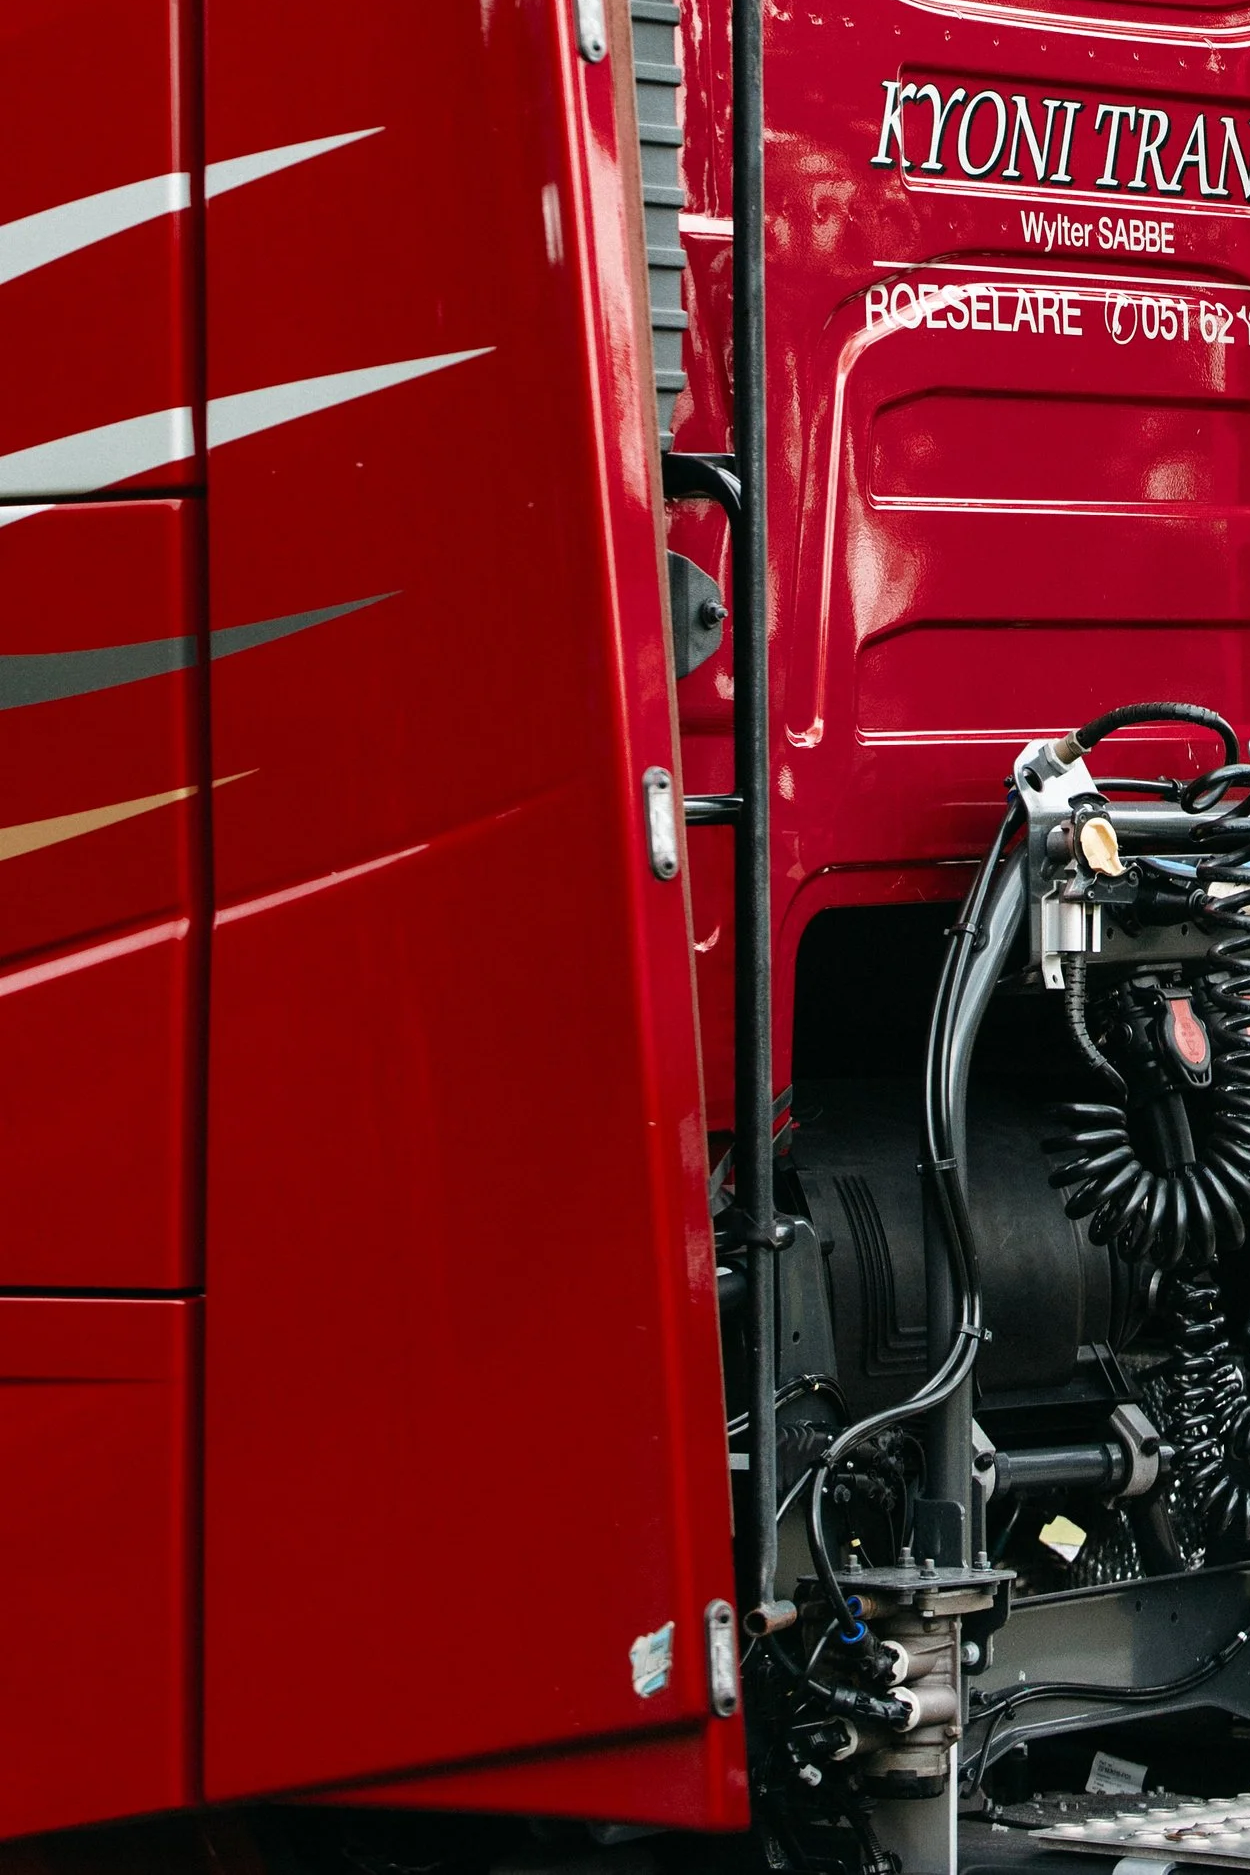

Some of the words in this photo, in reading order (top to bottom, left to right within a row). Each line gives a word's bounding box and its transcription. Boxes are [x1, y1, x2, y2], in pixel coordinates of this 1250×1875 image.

[869, 79, 1083, 185] KYONI
[1020, 210, 1094, 253] Wylter
[1098, 216, 1176, 255] SABBE
[865, 282, 1083, 336] ROESELARE
[1141, 296, 1190, 342] 051
[1199, 300, 1235, 344] 62
